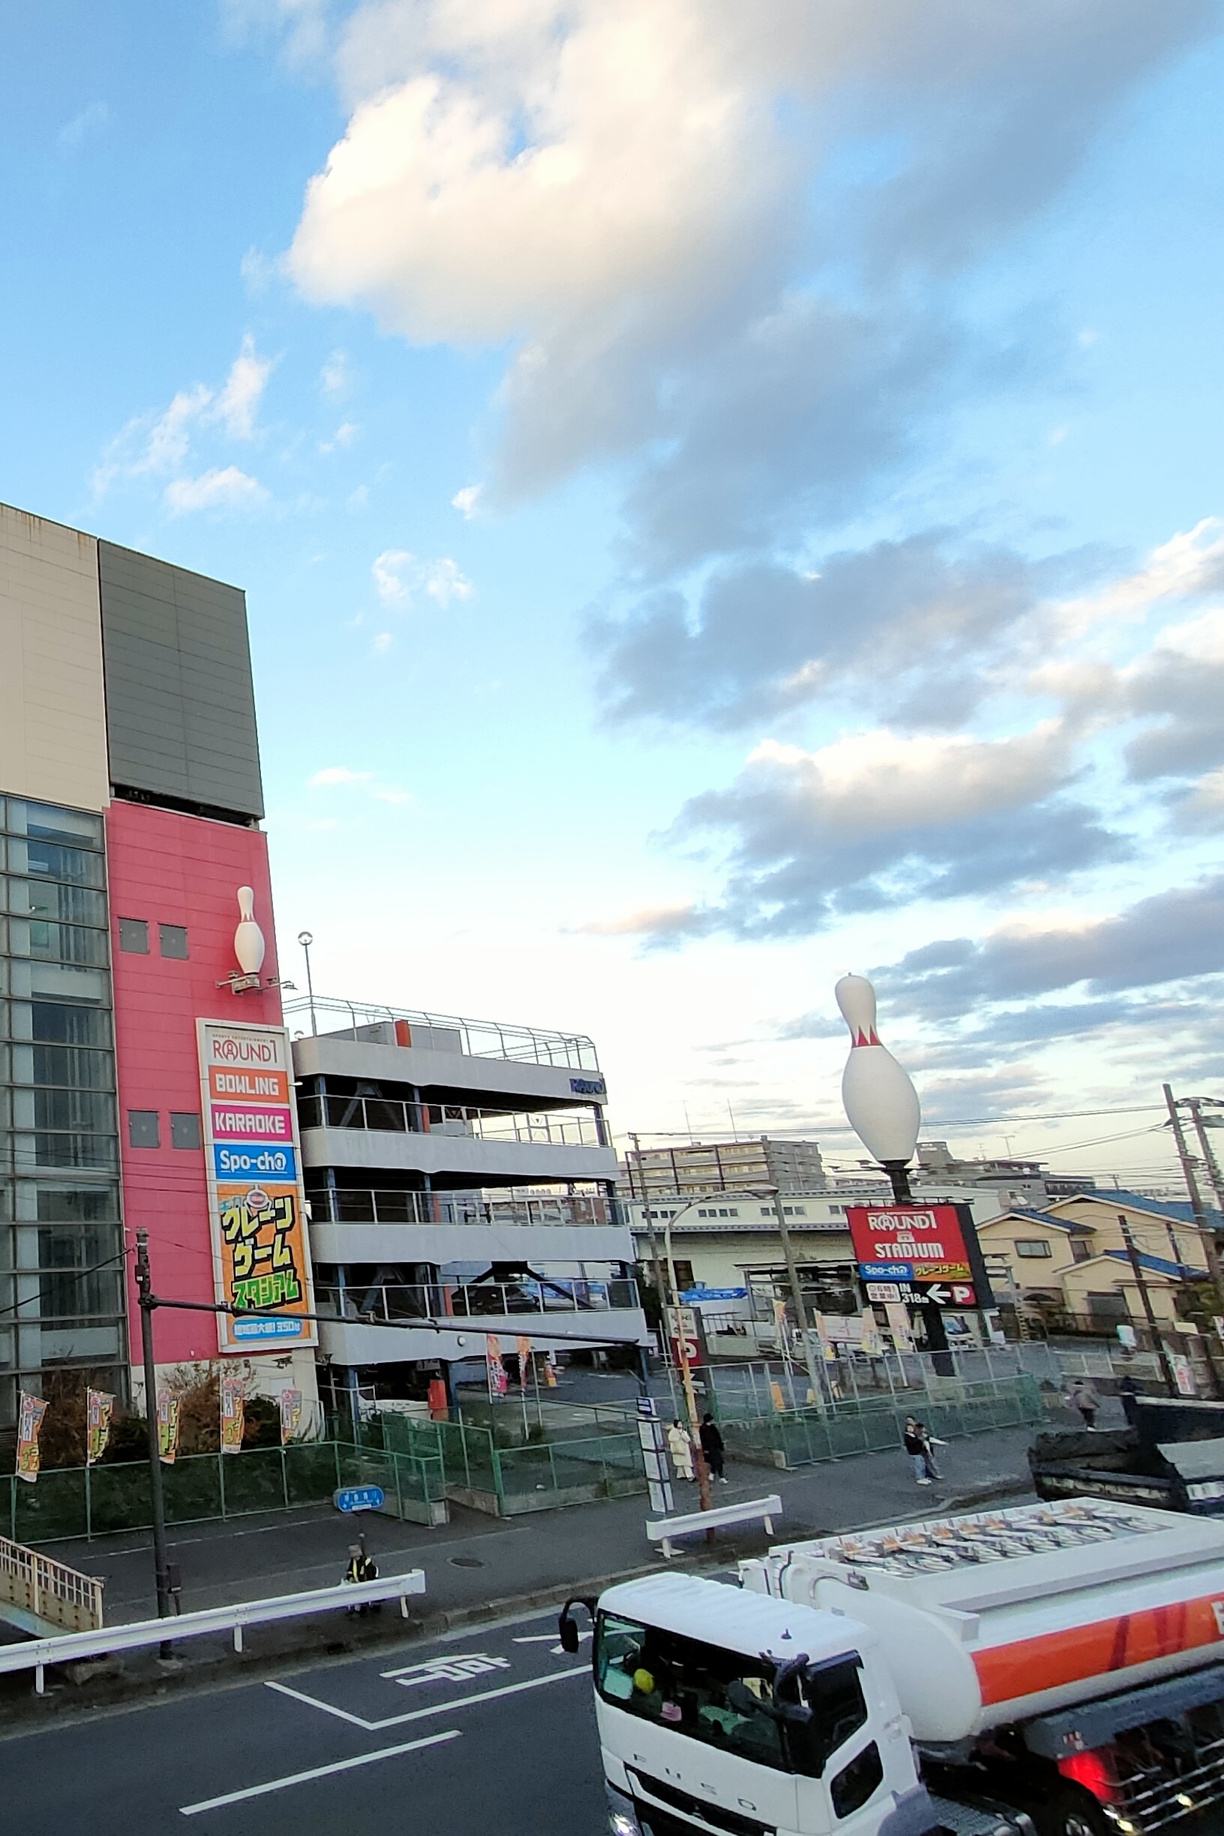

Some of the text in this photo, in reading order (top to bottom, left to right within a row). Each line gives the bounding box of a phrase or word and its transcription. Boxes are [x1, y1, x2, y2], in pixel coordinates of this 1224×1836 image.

[213, 1039, 277, 1063] ROUND1
[215, 1073, 279, 1096] BOWLING
[215, 1112, 286, 1134] KARAOKE
[222, 1197, 293, 1240] クレーン
[867, 1210, 937, 1231] ROUND1
[234, 1234, 292, 1277] ゲーム
[874, 1242, 945, 1258] STADIUM
[232, 1269, 299, 1309] スタジアム
[899, 1283, 911, 1293] IN
[953, 1286, 970, 1302] P
